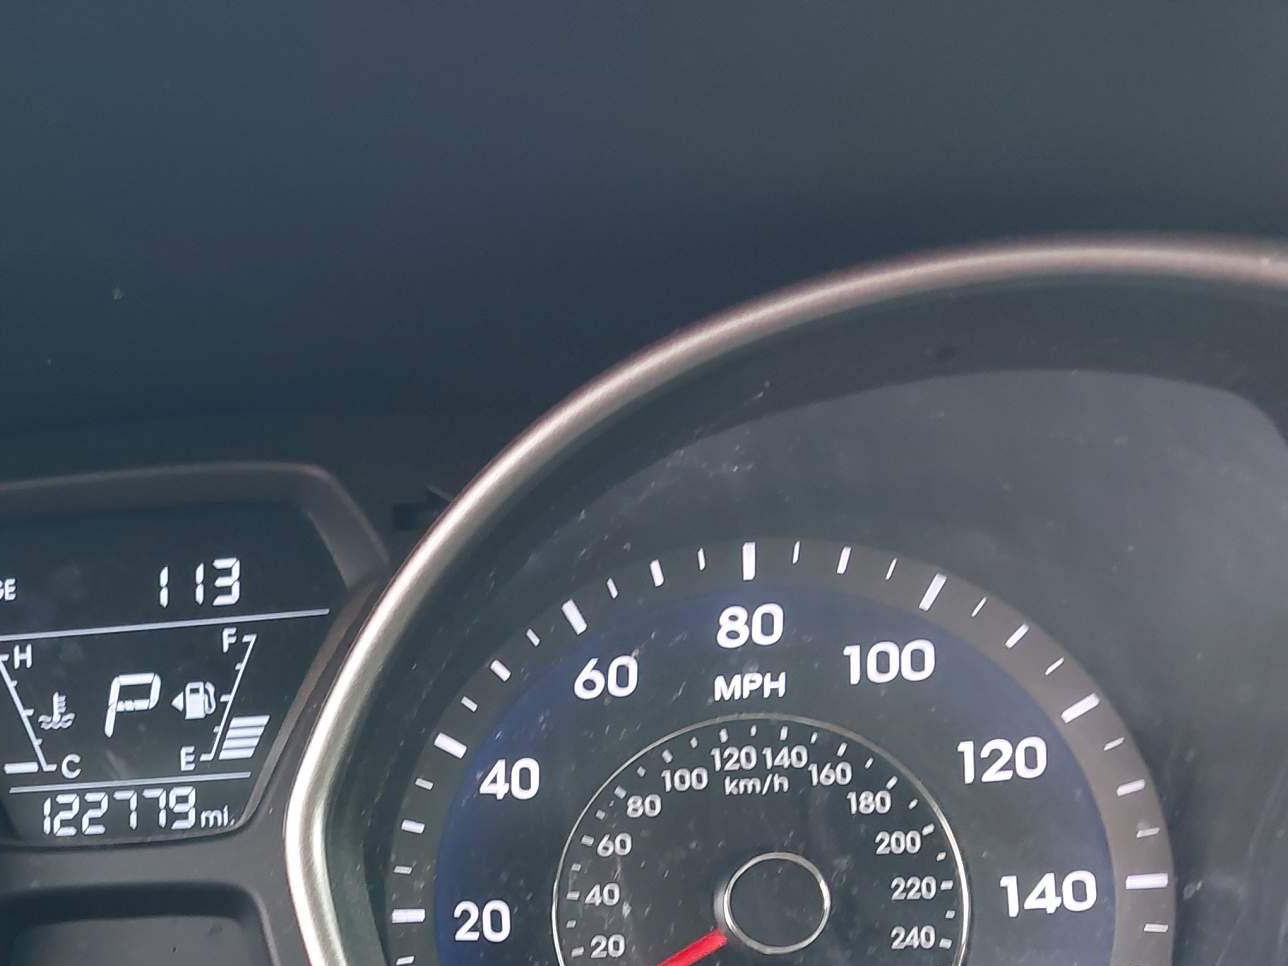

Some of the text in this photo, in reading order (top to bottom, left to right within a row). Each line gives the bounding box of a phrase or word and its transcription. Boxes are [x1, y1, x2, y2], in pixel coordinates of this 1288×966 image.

[159, 557, 240, 607] 113
[716, 603, 784, 649] 80
[222, 627, 237, 652] F
[13, 644, 33, 669] H
[843, 639, 936, 685] 100
[573, 655, 640, 700] 60
[713, 671, 786, 702] MPH
[104, 673, 161, 738] P
[61, 755, 81, 778] C
[180, 747, 196, 771] E
[711, 745, 757, 771] 120
[761, 745, 808, 770] 140
[957, 737, 1048, 783] 120
[479, 758, 541, 800] 40
[661, 766, 708, 792] 100
[723, 772, 789, 796] km/h
[808, 761, 853, 788] 160
[43, 786, 235, 837] 122779 mi.
[626, 794, 662, 818] 80
[847, 789, 891, 815] 180
[597, 833, 633, 857] 60
[875, 831, 921, 856] 200
[584, 882, 621, 907] 40
[890, 877, 937, 900] 220
[1000, 870, 1097, 918] 140
[453, 900, 511, 942] 20
[590, 934, 626, 958] 20
[890, 926, 936, 949] 240
